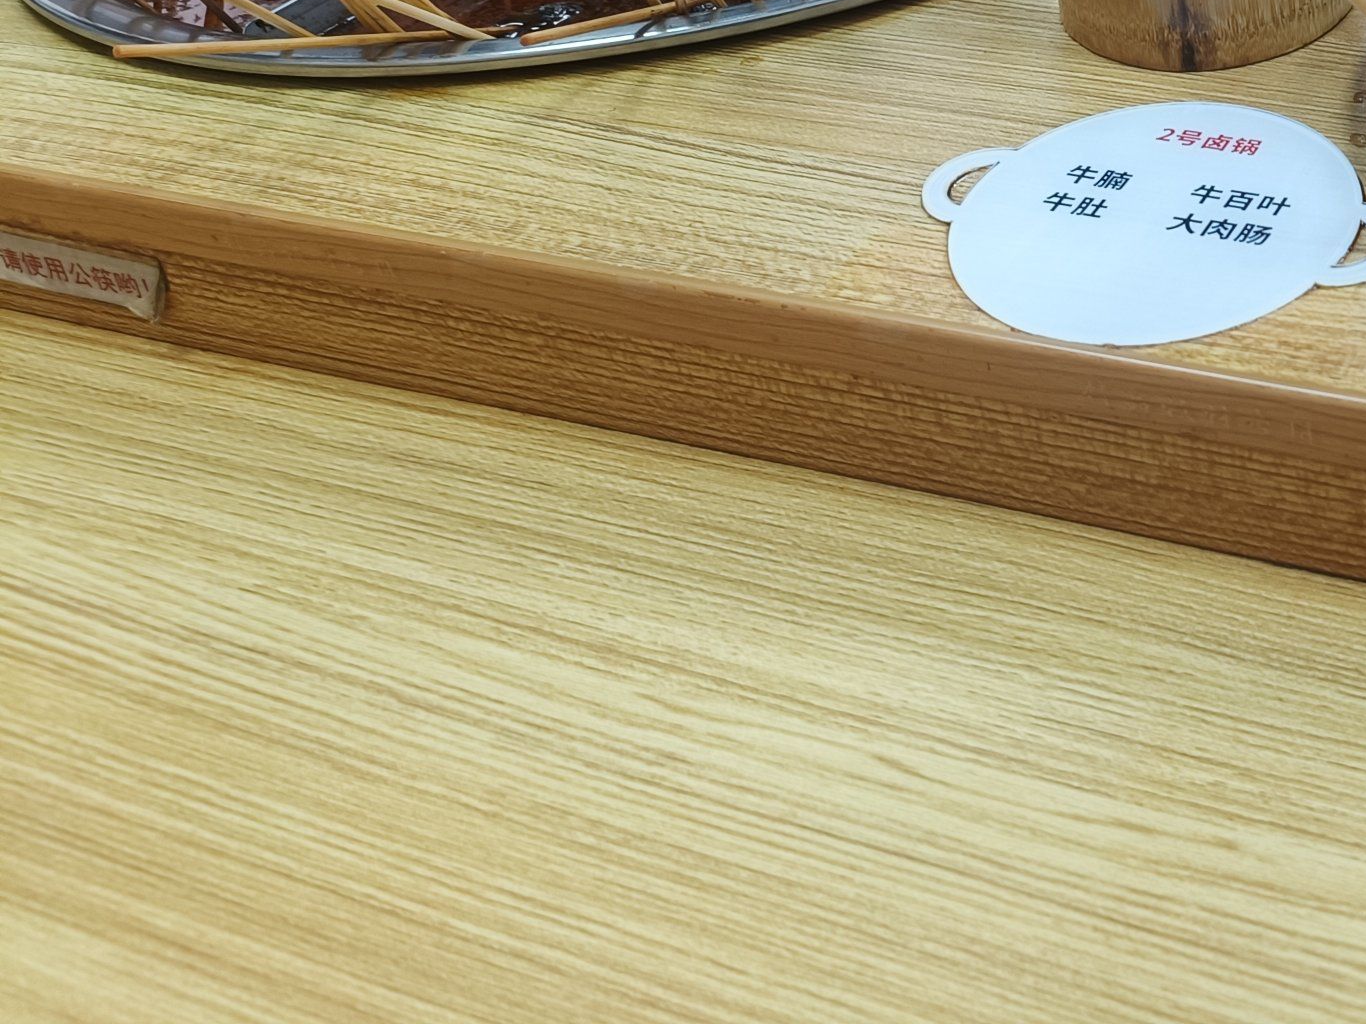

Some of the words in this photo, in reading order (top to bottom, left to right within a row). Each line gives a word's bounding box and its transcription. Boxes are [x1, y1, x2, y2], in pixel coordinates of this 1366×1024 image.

[1156, 128, 1263, 156] 2号卤锅
[1066, 164, 1133, 190] 牛腩
[1190, 184, 1291, 216] 牛百叶
[1043, 192, 1108, 218] 牛肚
[1166, 213, 1273, 246] 大肉肠
